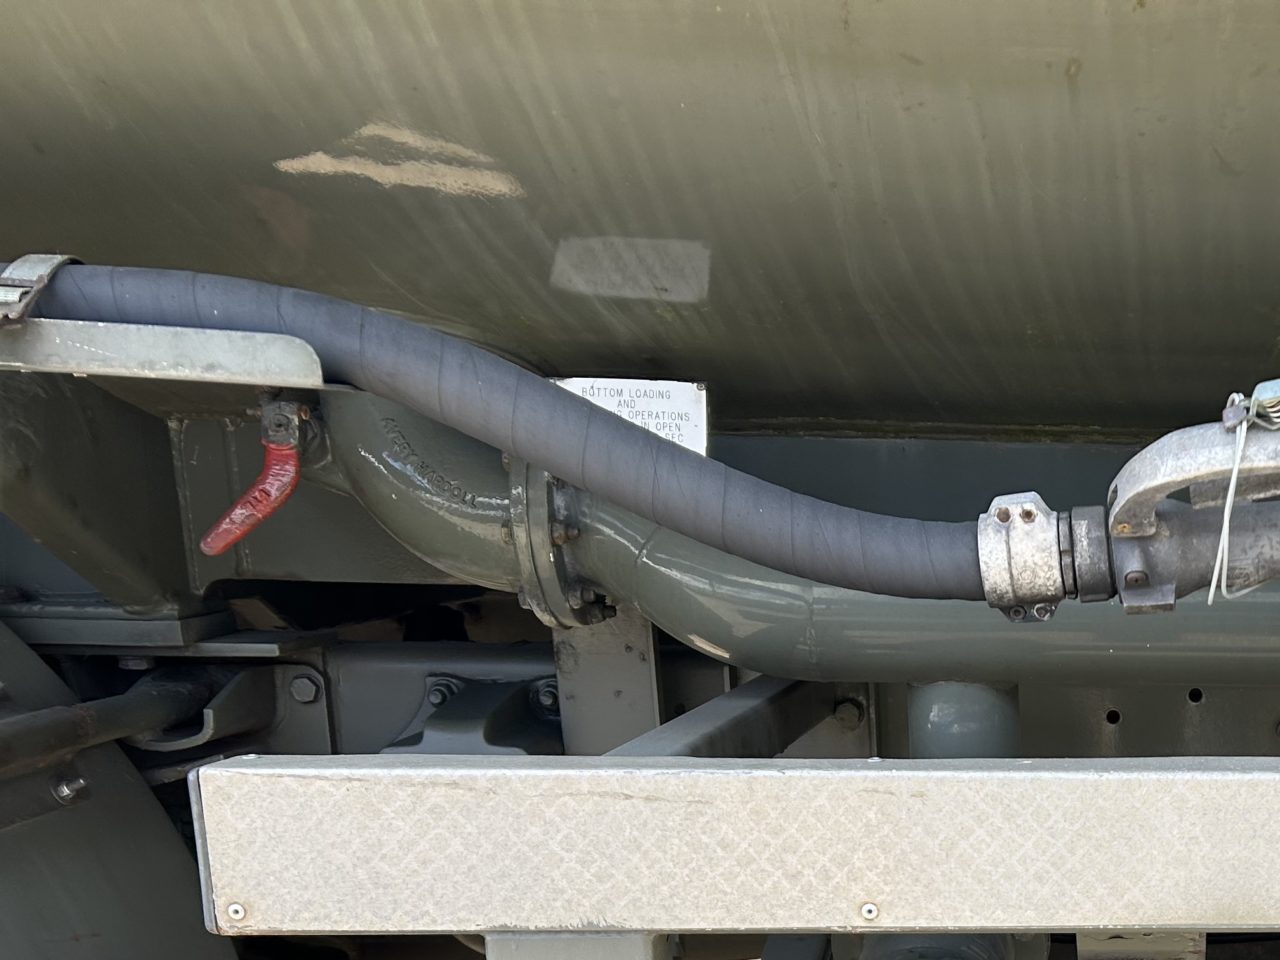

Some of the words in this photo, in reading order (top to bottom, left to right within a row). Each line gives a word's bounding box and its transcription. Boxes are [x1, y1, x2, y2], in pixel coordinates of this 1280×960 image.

[581, 386, 624, 399] BOTTOM
[629, 388, 671, 400] LOADING
[616, 399, 636, 409] AND
[628, 410, 690, 421] OPERATIONS
[655, 421, 681, 432] OPEN
